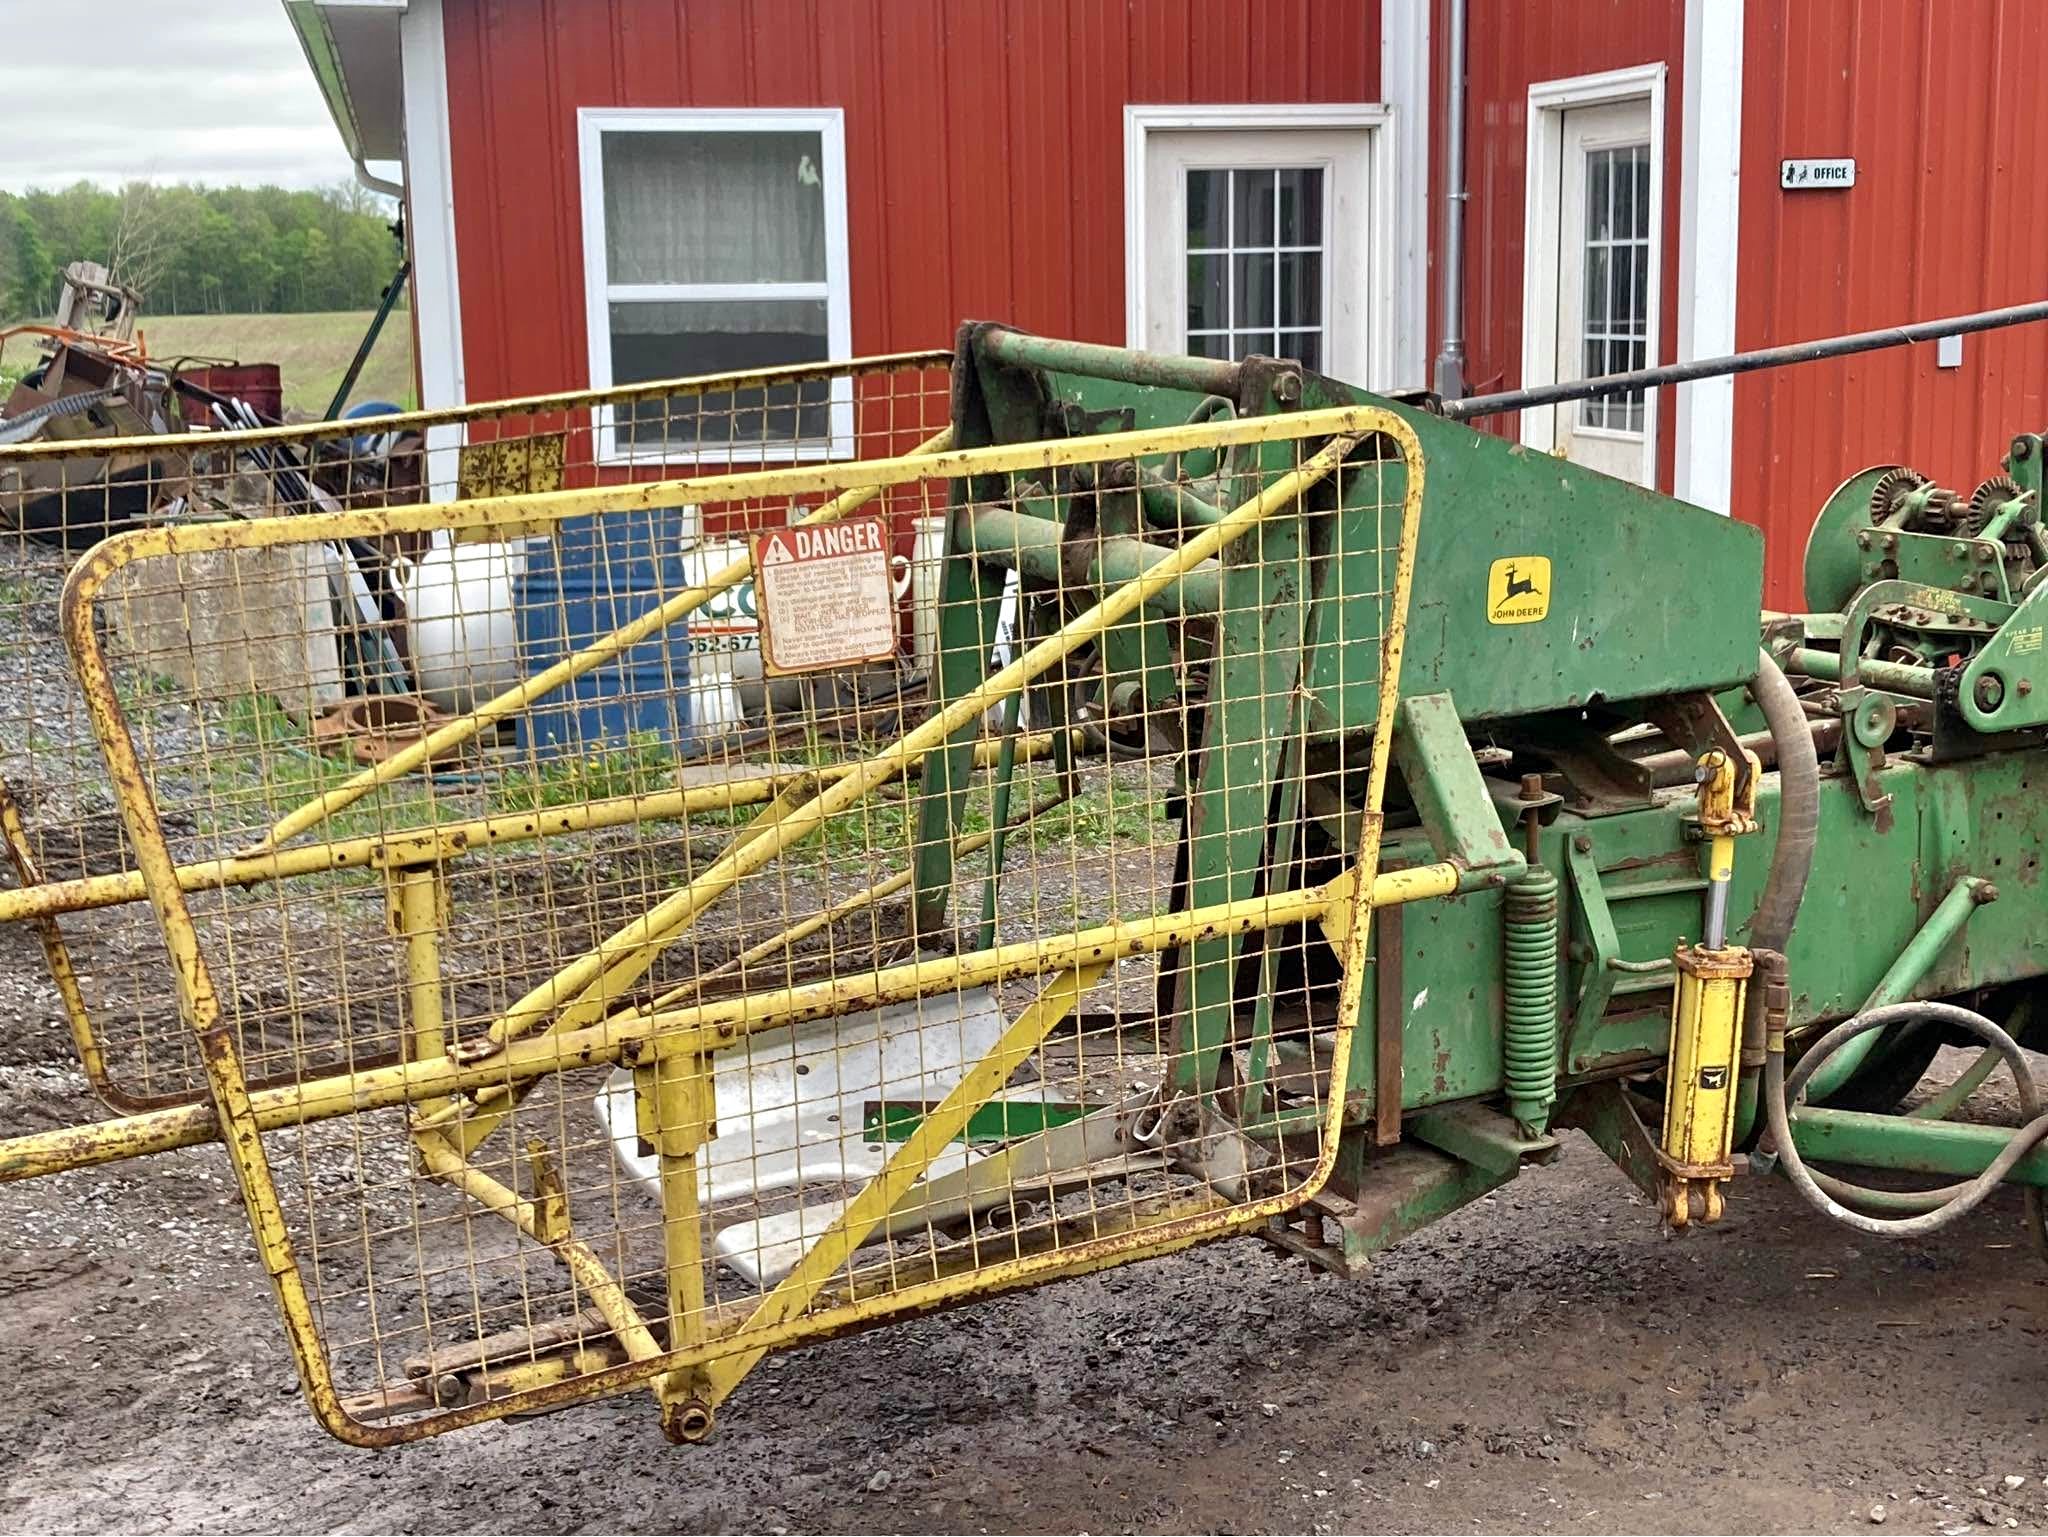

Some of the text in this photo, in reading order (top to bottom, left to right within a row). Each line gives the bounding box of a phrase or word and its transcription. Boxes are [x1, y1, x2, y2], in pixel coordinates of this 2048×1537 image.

[1814, 167, 1847, 180] OFFICE
[795, 522, 881, 559] DANGER
[1492, 607, 1544, 619] JOHN DEERE
